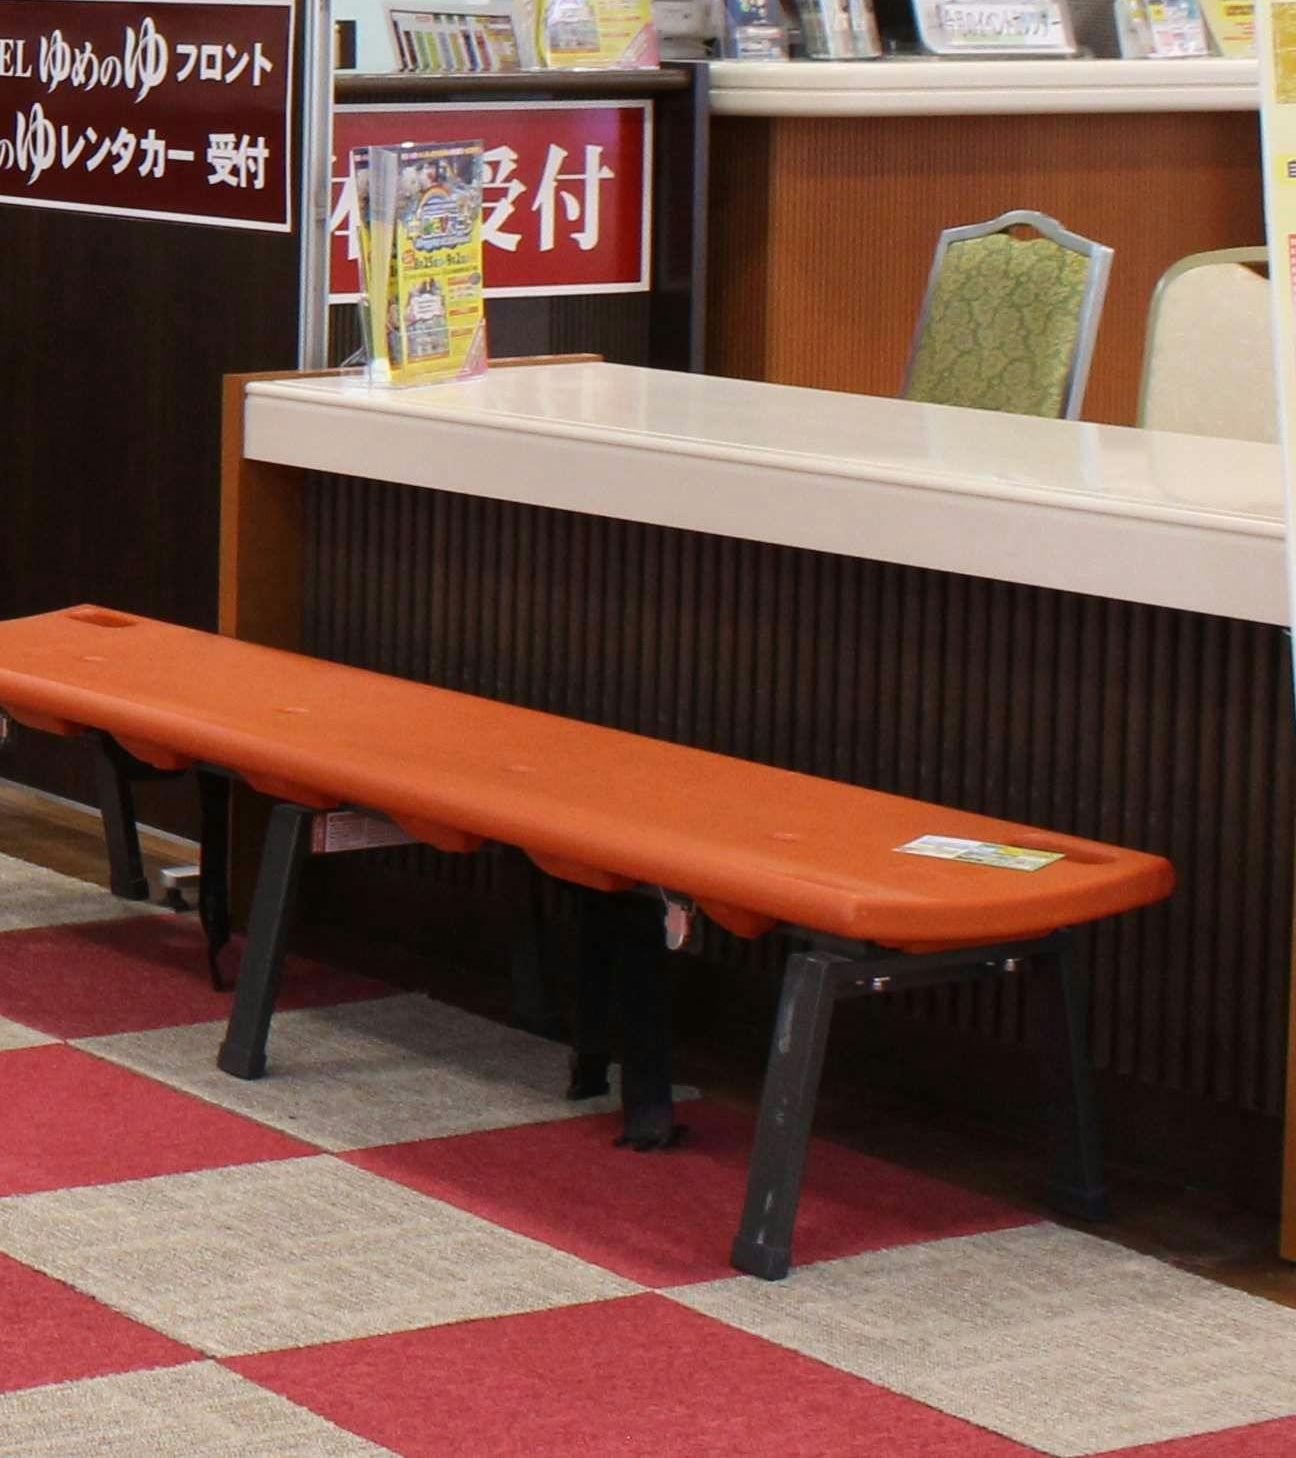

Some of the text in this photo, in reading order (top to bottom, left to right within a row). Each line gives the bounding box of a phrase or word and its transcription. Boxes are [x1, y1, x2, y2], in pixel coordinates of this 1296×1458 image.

[37, 15, 169, 102] ゆめのゆ
[174, 42, 275, 87] フロント
[205, 132, 270, 190] 受付
